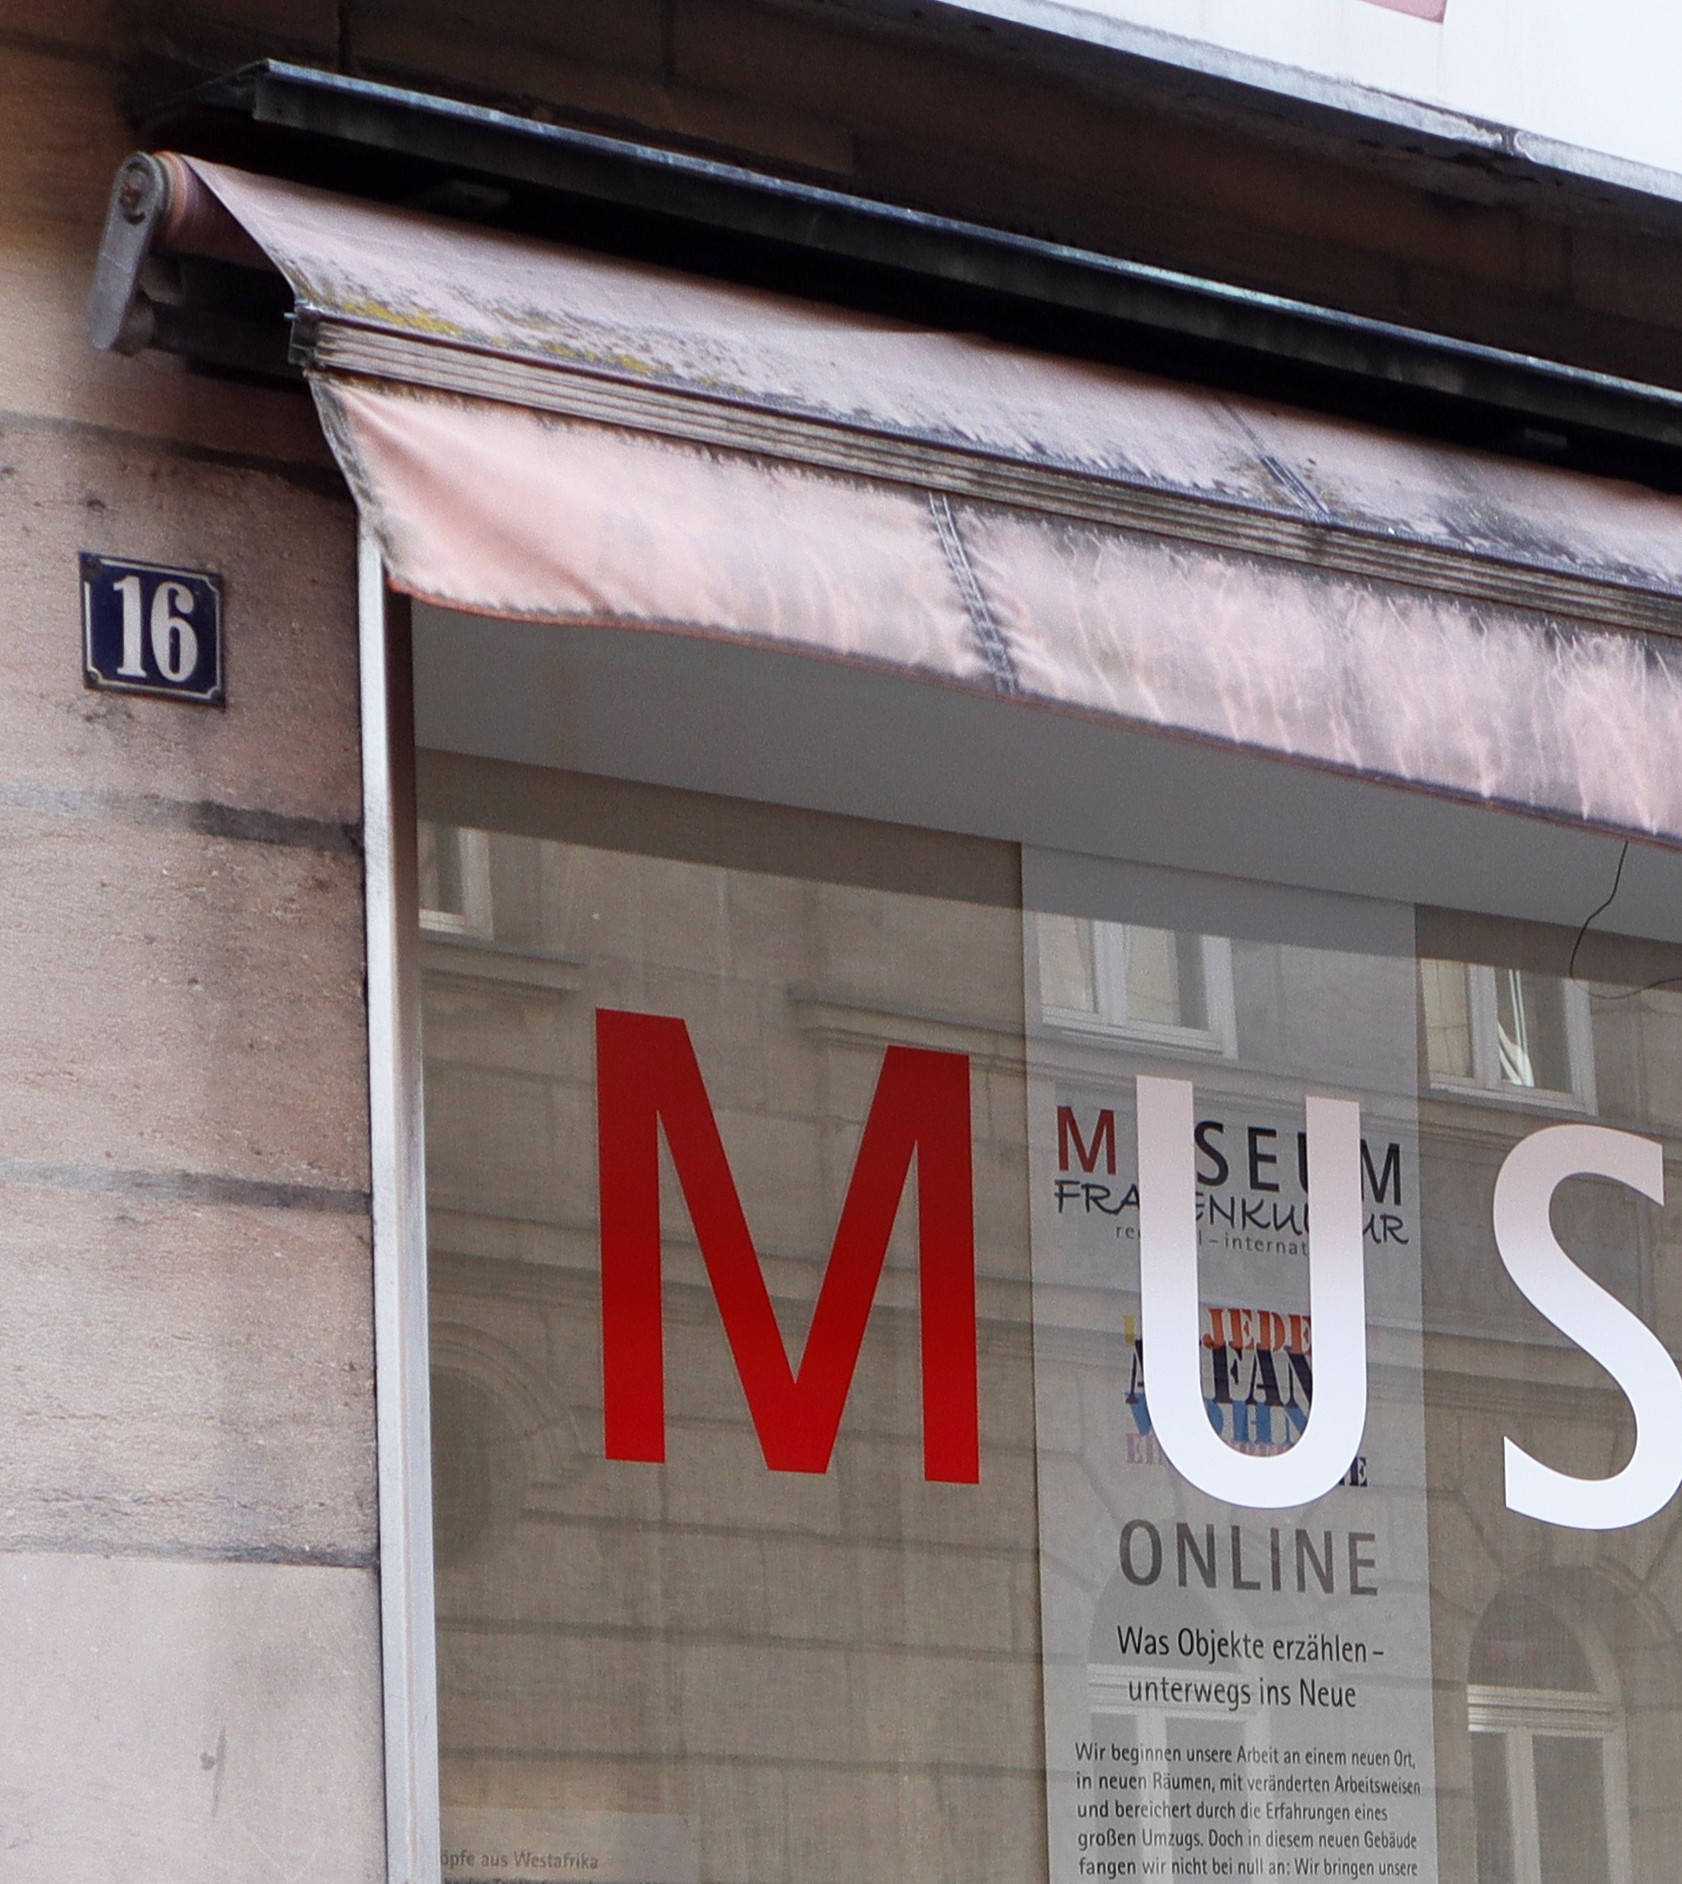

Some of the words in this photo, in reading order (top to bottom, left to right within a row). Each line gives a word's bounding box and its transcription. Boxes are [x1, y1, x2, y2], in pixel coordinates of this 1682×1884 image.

[113, 574, 199, 683] 16
[1119, 1519, 1378, 1596] ONLINE
[1118, 1625, 1170, 1655] Was
[1179, 1628, 1264, 1664] Objekte
[1273, 1634, 1366, 1662] erzählen
[1129, 1678, 1250, 1710] unterwegs
[1260, 1681, 1291, 1705] ins
[1300, 1679, 1356, 1707] Neue
[1075, 1742, 1105, 1761] Wir
[1111, 1745, 1181, 1765] beginnen
[1186, 1746, 1231, 1763] unsere
[1237, 1746, 1278, 1764] Arbeit
[1283, 1750, 1300, 1764] an
[1305, 1748, 1346, 1765] einem
[1351, 1750, 1390, 1766] neuen
[1395, 1750, 1415, 1768] Ort,
[1076, 1772, 1091, 1790] in
[1099, 1774, 1146, 1790] neuen
[1153, 1772, 1215, 1793] Räumen,
[1220, 1773, 1243, 1792] mit
[1247, 1775, 1329, 1793] veränderten
[1334, 1775, 1420, 1795] Arbeitsweisen
[1078, 1801, 1108, 1818] und
[1115, 1801, 1191, 1818] bereichert
[1196, 1803, 1235, 1819] durch
[1240, 1804, 1261, 1819] die
[1266, 1803, 1350, 1823] Erfahrungen
[1355, 1805, 1387, 1821] eines
[1078, 1829, 1136, 1850] großen
[1142, 1831, 1203, 1850] Umzugs.
[1208, 1831, 1243, 1846] Doch
[1248, 1832, 1261, 1847] in
[1266, 1832, 1313, 1848] diesem
[1318, 1834, 1359, 1848] neuen
[1364, 1832, 1416, 1849] Gebäude
[514, 1851, 598, 1869] Westafrika
[1079, 1857, 1136, 1878] fangen
[1142, 1859, 1165, 1874] wir
[1171, 1858, 1207, 1875] nicht
[1212, 1859, 1233, 1875] bei
[1238, 1858, 1263, 1875] null
[1268, 1862, 1290, 1876] an:
[1294, 1859, 1319, 1876] Wir
[1324, 1860, 1374, 1879] bringen
[1378, 1862, 1417, 1876] unsere
